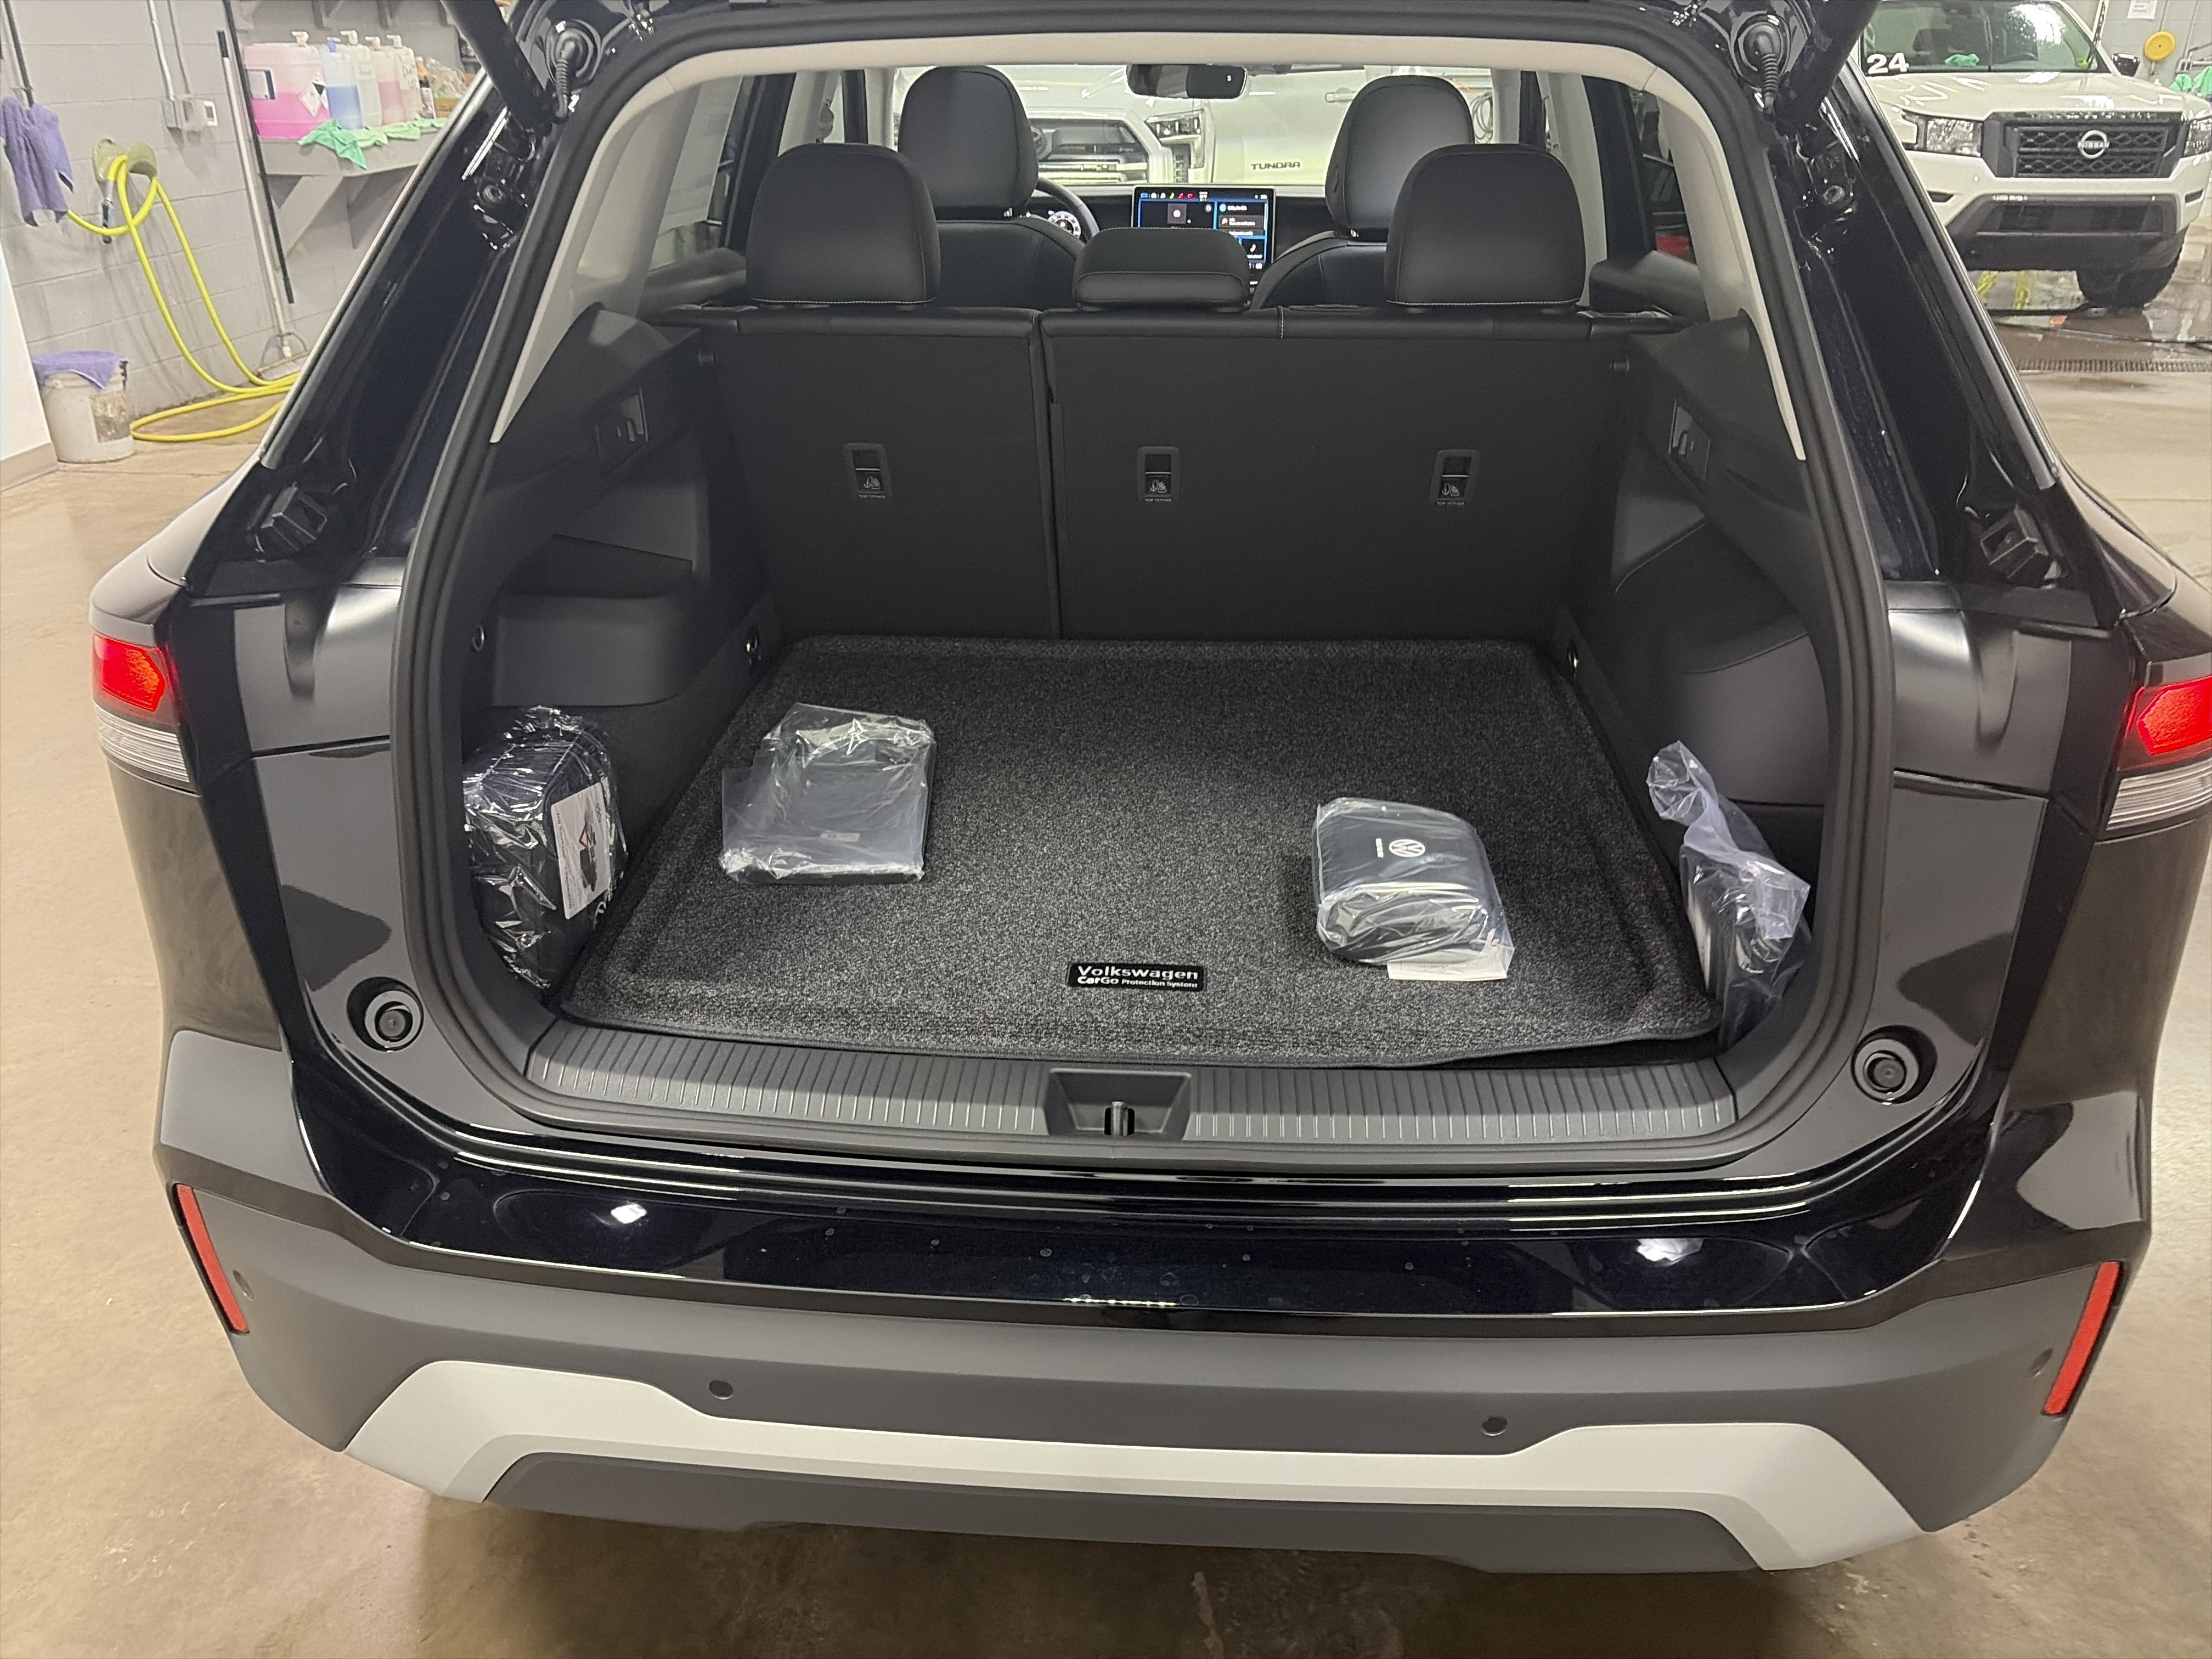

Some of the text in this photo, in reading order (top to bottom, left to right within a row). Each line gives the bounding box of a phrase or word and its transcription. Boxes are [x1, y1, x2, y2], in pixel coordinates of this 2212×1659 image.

[1867, 53, 1909, 74] 24
[1250, 161, 1300, 170] TUNDRA
[1077, 966, 1198, 980] Volkswagen
[1077, 976, 1119, 984] CarGo
